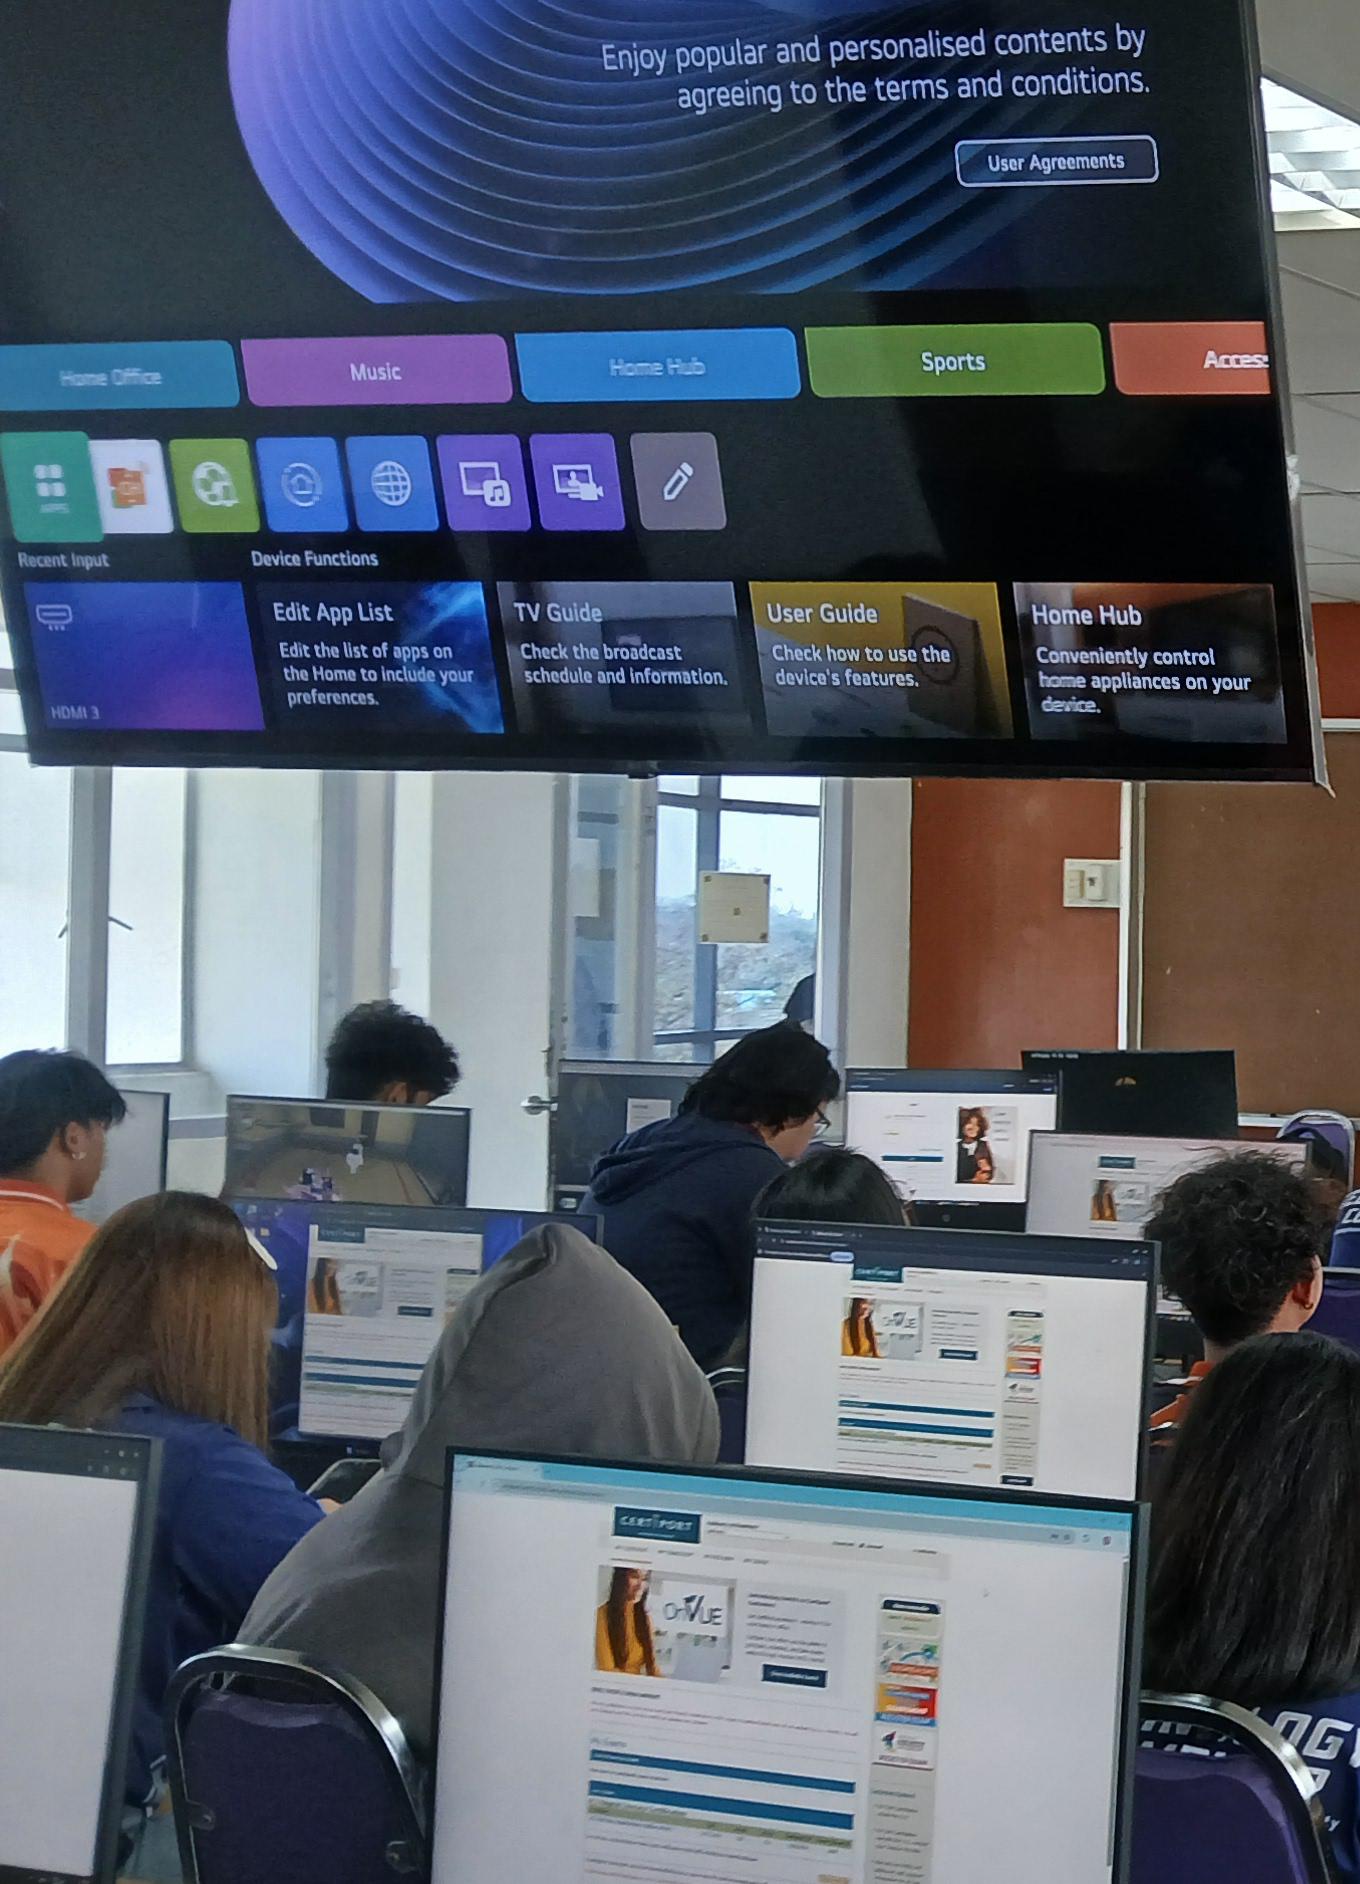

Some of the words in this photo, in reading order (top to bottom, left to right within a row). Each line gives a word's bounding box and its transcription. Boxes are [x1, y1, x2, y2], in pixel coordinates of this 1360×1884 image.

[602, 42, 667, 77] Enjoy
[675, 37, 768, 74] popular
[776, 34, 821, 64] and
[829, 27, 986, 69] personalised
[994, 27, 1108, 56] contents
[1115, 22, 1146, 58] by
[678, 78, 782, 116] agreeing
[789, 80, 817, 105] to
[824, 75, 867, 104] the
[874, 77, 949, 102] terms
[957, 69, 1003, 99] and
[1011, 65, 1150, 97] conditions.
[987, 154, 1025, 172] User
[1029, 153, 1125, 175] Agreements
[349, 362, 403, 381] Music
[610, 358, 664, 376] Home
[666, 357, 706, 376] Hub
[921, 351, 986, 377] Sports
[59, 370, 108, 387] Home
[111, 367, 163, 386] Office
[18, 552, 67, 568] Recent
[71, 552, 110, 571] Input
[250, 549, 302, 567] Device
[304, 549, 379, 567] Functions
[273, 601, 312, 622] Edit
[316, 602, 353, 627] App
[357, 602, 395, 622] List
[513, 602, 541, 622] TV
[546, 601, 603, 623] Guide
[766, 602, 814, 623] User
[819, 602, 878, 624] Guide
[1031, 604, 1093, 625] Home
[1098, 604, 1142, 626] Hub
[279, 641, 303, 658] Edit
[313, 641, 340, 659] the
[342, 641, 369, 659] list
[371, 641, 389, 659] of
[393, 646, 430, 663] apps
[432, 646, 453, 659] on
[520, 642, 569, 660] Check
[572, 642, 600, 660] the
[602, 643, 683, 661] broadcast
[772, 643, 823, 662] Check
[826, 644, 860, 662] how
[864, 646, 884, 662] to
[887, 648, 917, 663] use
[921, 644, 951, 663] the
[1036, 646, 1149, 669] Conveniently
[1152, 647, 1216, 666] control
[283, 665, 309, 682] the
[312, 665, 357, 682] Home
[359, 667, 378, 682] to
[381, 665, 436, 683] include
[439, 670, 474, 687] your
[524, 666, 593, 684] schedule
[597, 666, 626, 684] and
[629, 667, 728, 686] information.
[775, 668, 841, 686] device's
[844, 668, 919, 688] features.
[1038, 670, 1087, 689] home
[1090, 671, 1181, 694] appliances
[1185, 676, 1208, 690] on
[1211, 677, 1252, 695] your
[287, 687, 380, 709] preferences.
[1041, 695, 1101, 714] device.
[50, 705, 88, 720] HDMI
[90, 705, 100, 720] 3
